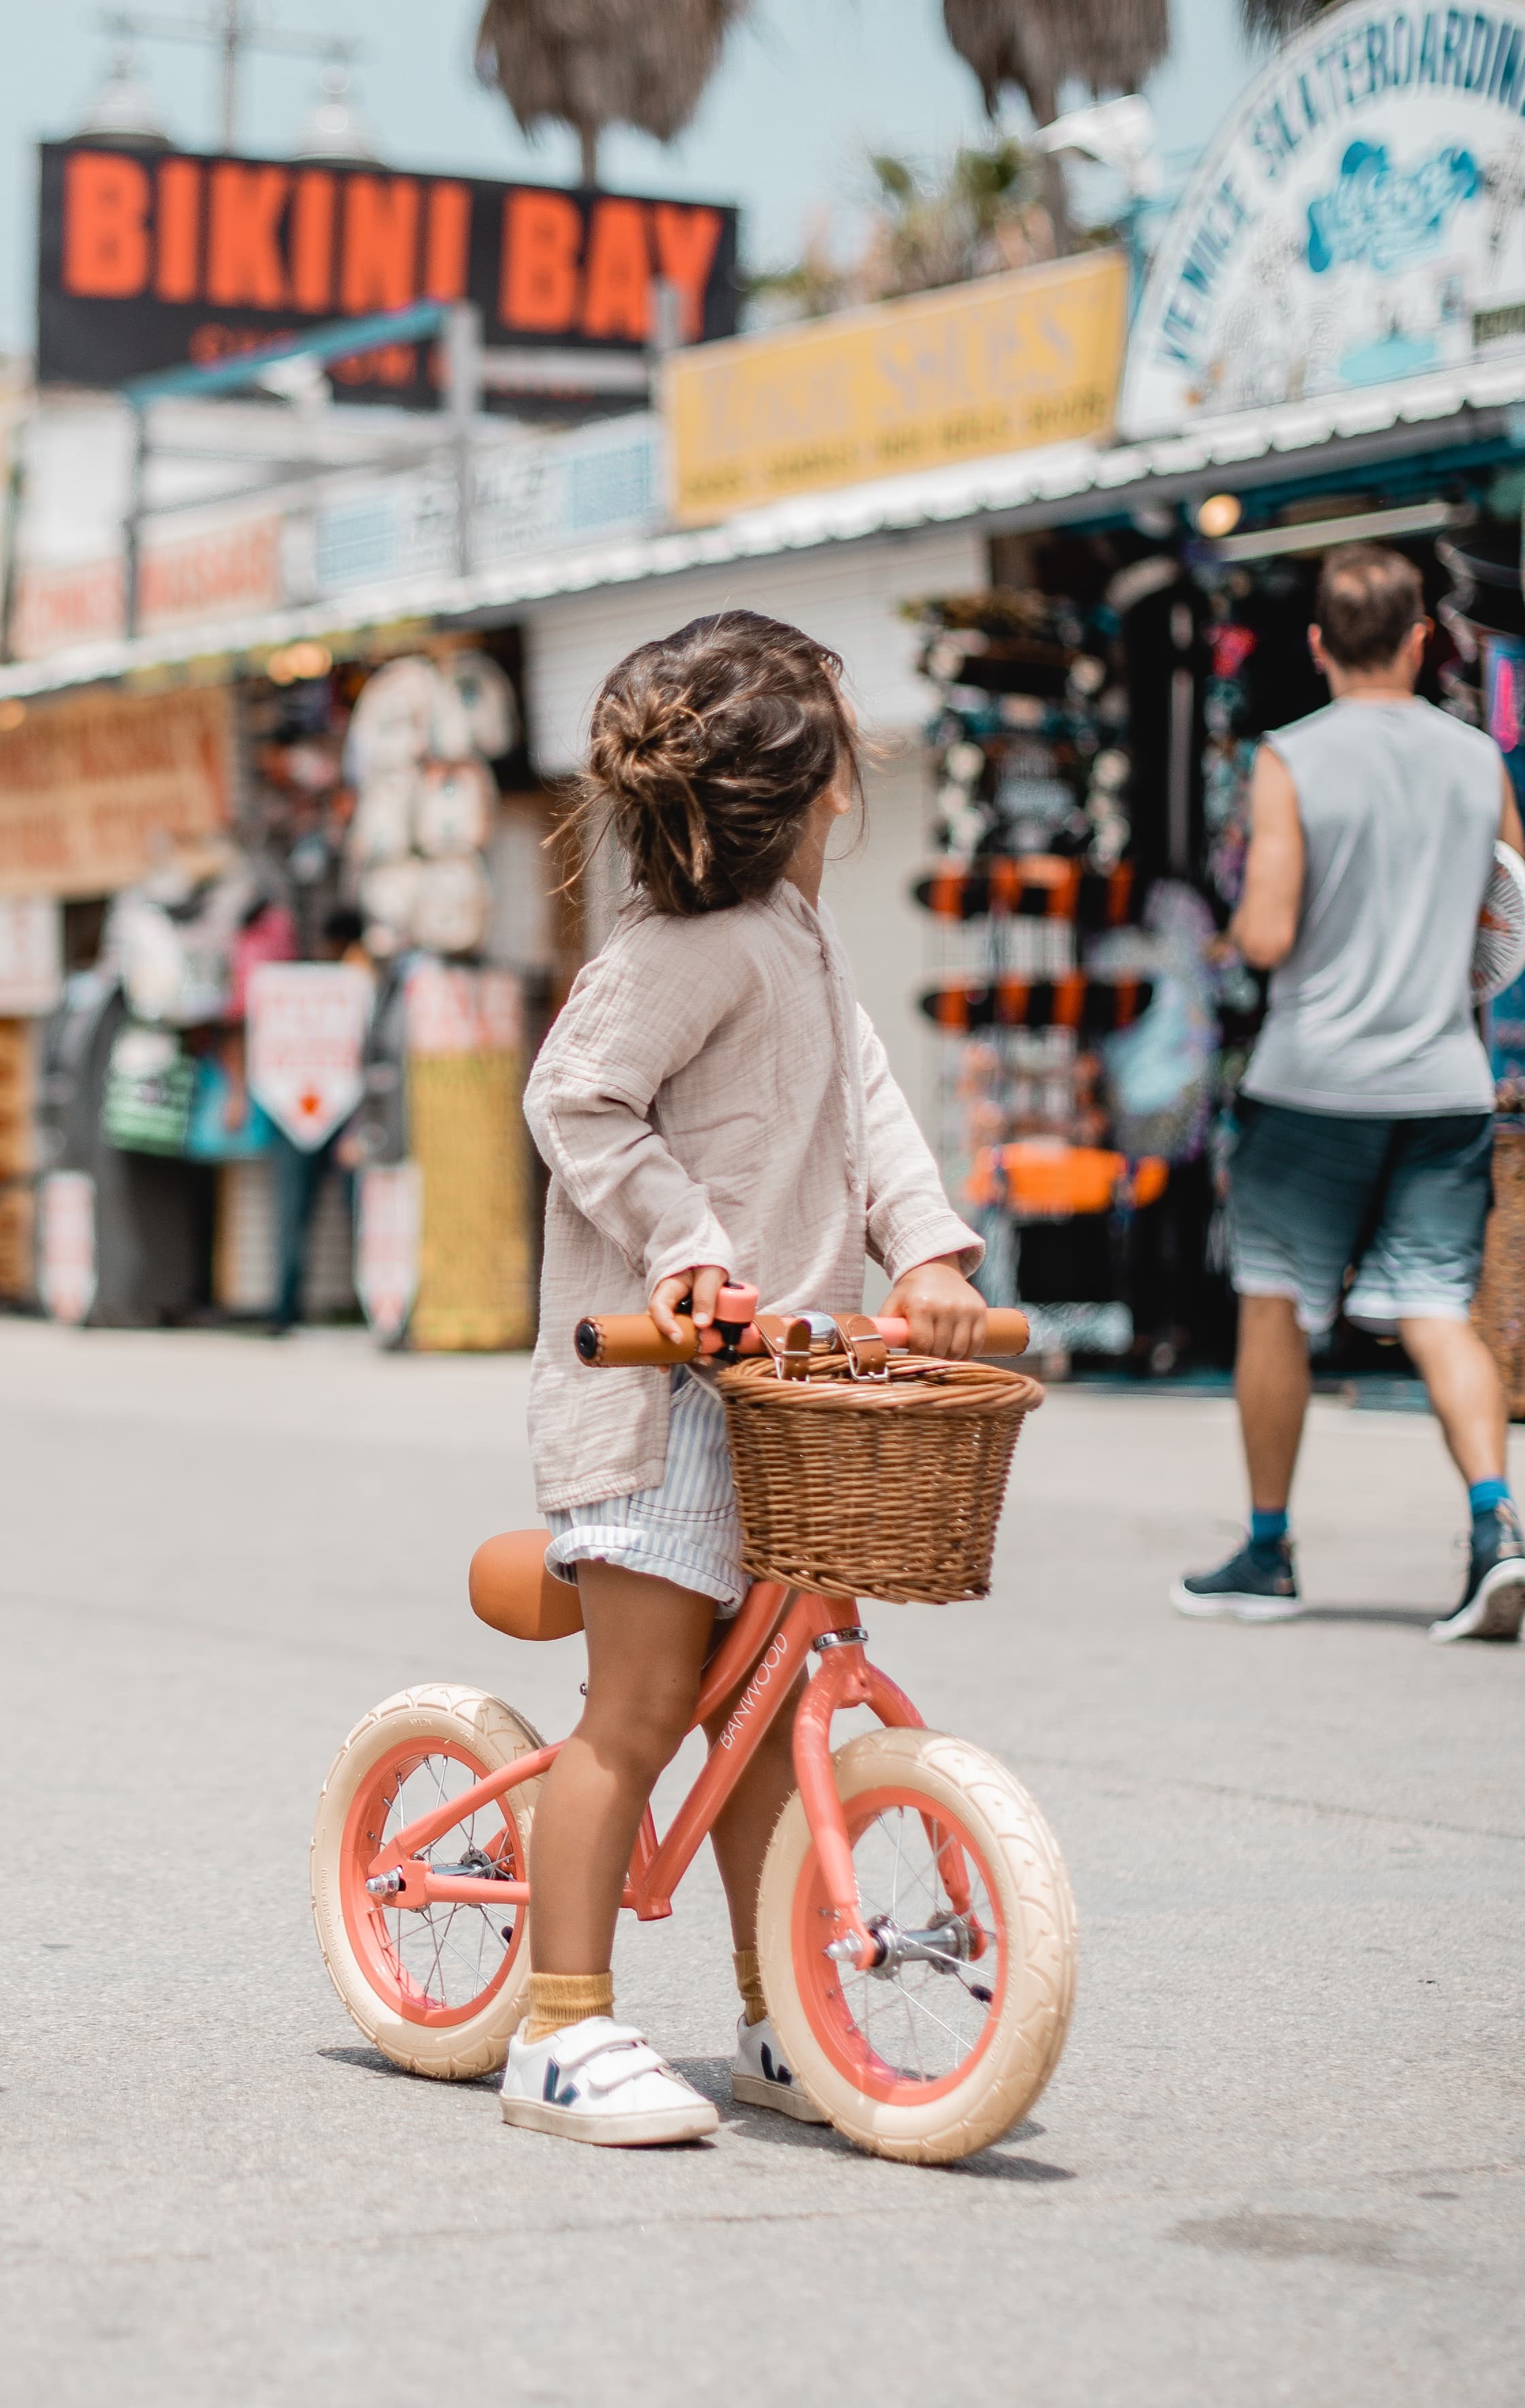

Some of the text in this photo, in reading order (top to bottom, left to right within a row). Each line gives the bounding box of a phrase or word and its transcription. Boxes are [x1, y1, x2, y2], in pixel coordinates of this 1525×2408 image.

[62, 148, 723, 345] BIKINI BAY
[719, 1632, 788, 1751] BANWOOD
